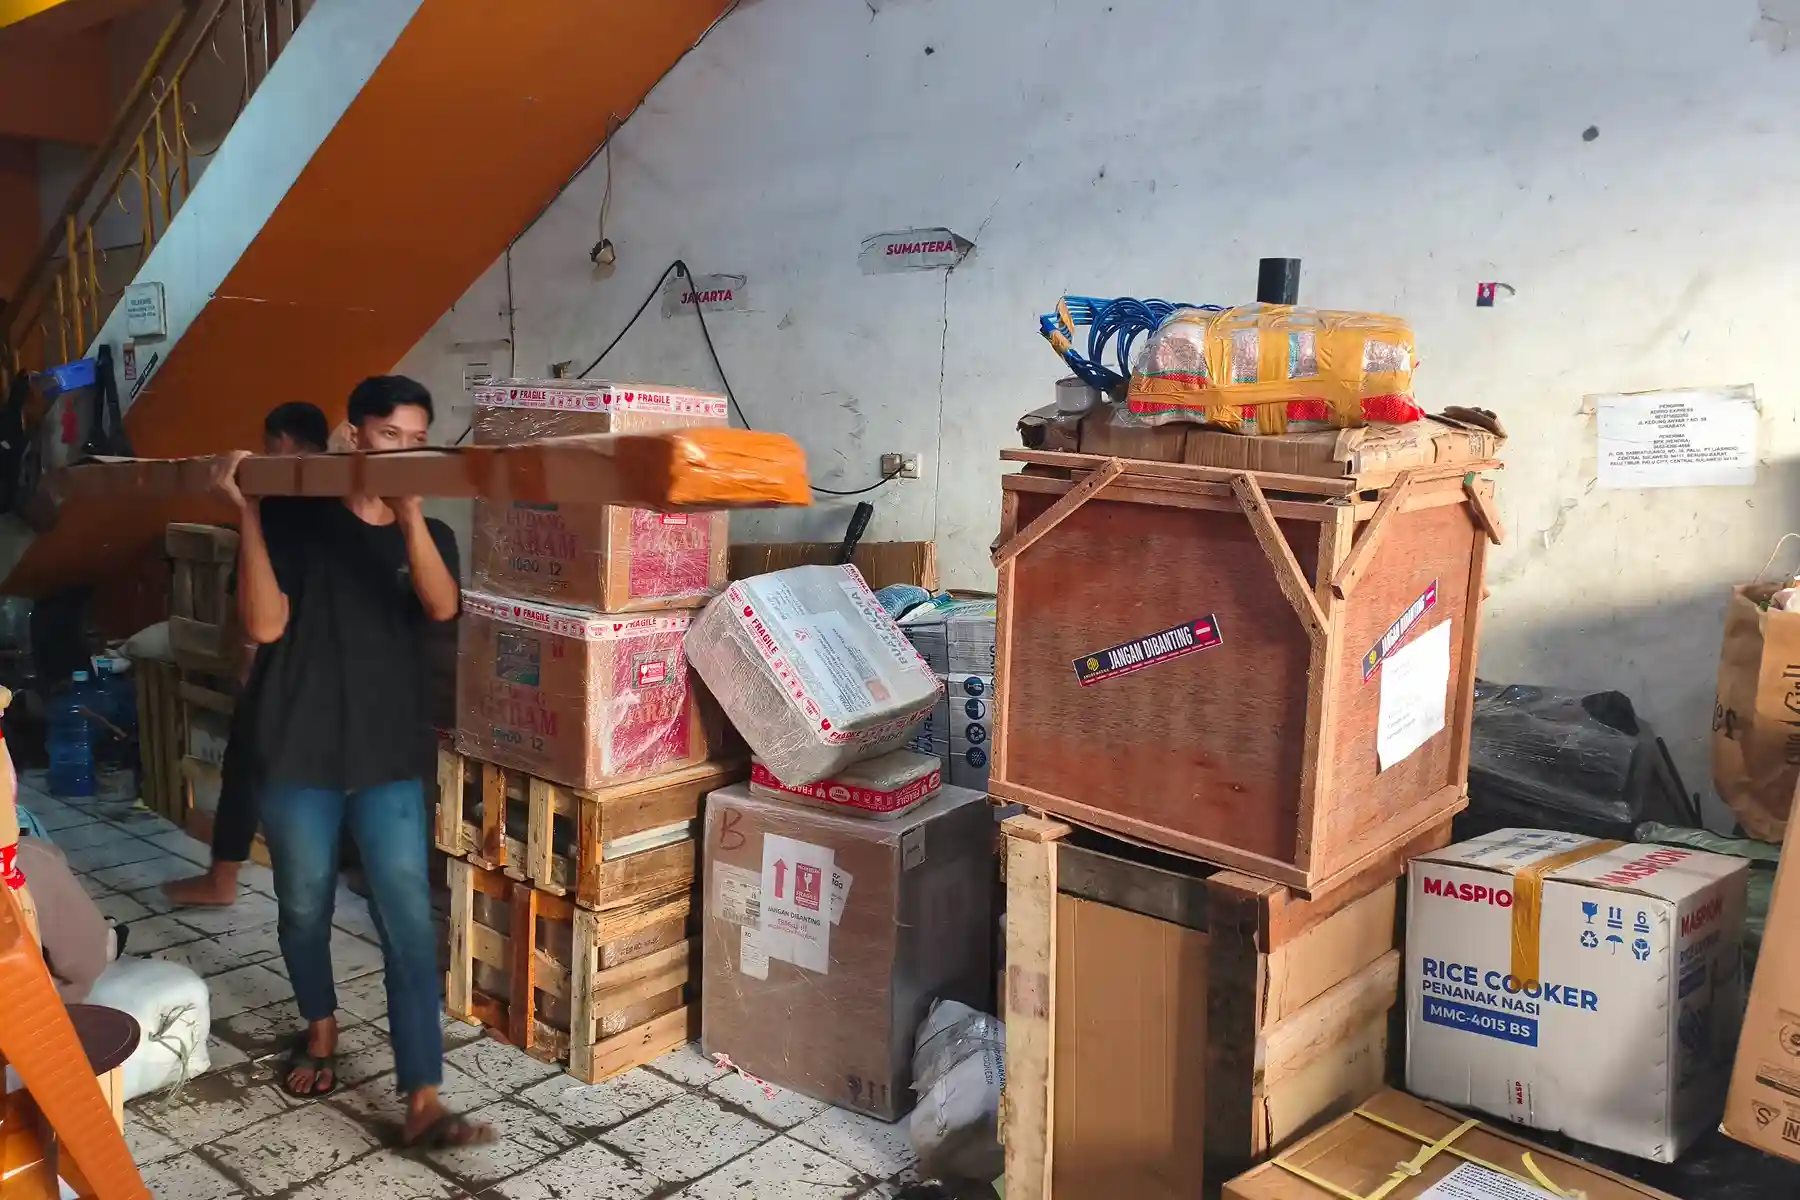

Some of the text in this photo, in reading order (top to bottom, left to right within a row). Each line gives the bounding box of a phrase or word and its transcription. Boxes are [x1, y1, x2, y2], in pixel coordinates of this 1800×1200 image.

[886, 241, 953, 255] SUMATERA
[681, 290, 732, 303] JAKARTA
[519, 389, 547, 400] FRAGILE
[637, 393, 671, 404] FRAGILE
[549, 561, 562, 576] 12
[523, 608, 550, 623] FRAGILE
[625, 618, 658, 630] FRAGILE
[751, 617, 779, 655] FRAGILE
[1107, 626, 1194, 670] JANGAN DIBANTING
[529, 737, 544, 752] 12
[720, 808, 746, 850] B
[1595, 848, 1692, 885] MASPION
[1423, 876, 1513, 908] MASPIO
[767, 906, 821, 927] JANGAN DIBANTING
[1422, 957, 1598, 1012] RICE COOKER
[1422, 979, 1540, 1015] PENANAK NASI
[1430, 1003, 1531, 1037] MMC-4015 BS
[1781, 1121, 1800, 1141] IN
